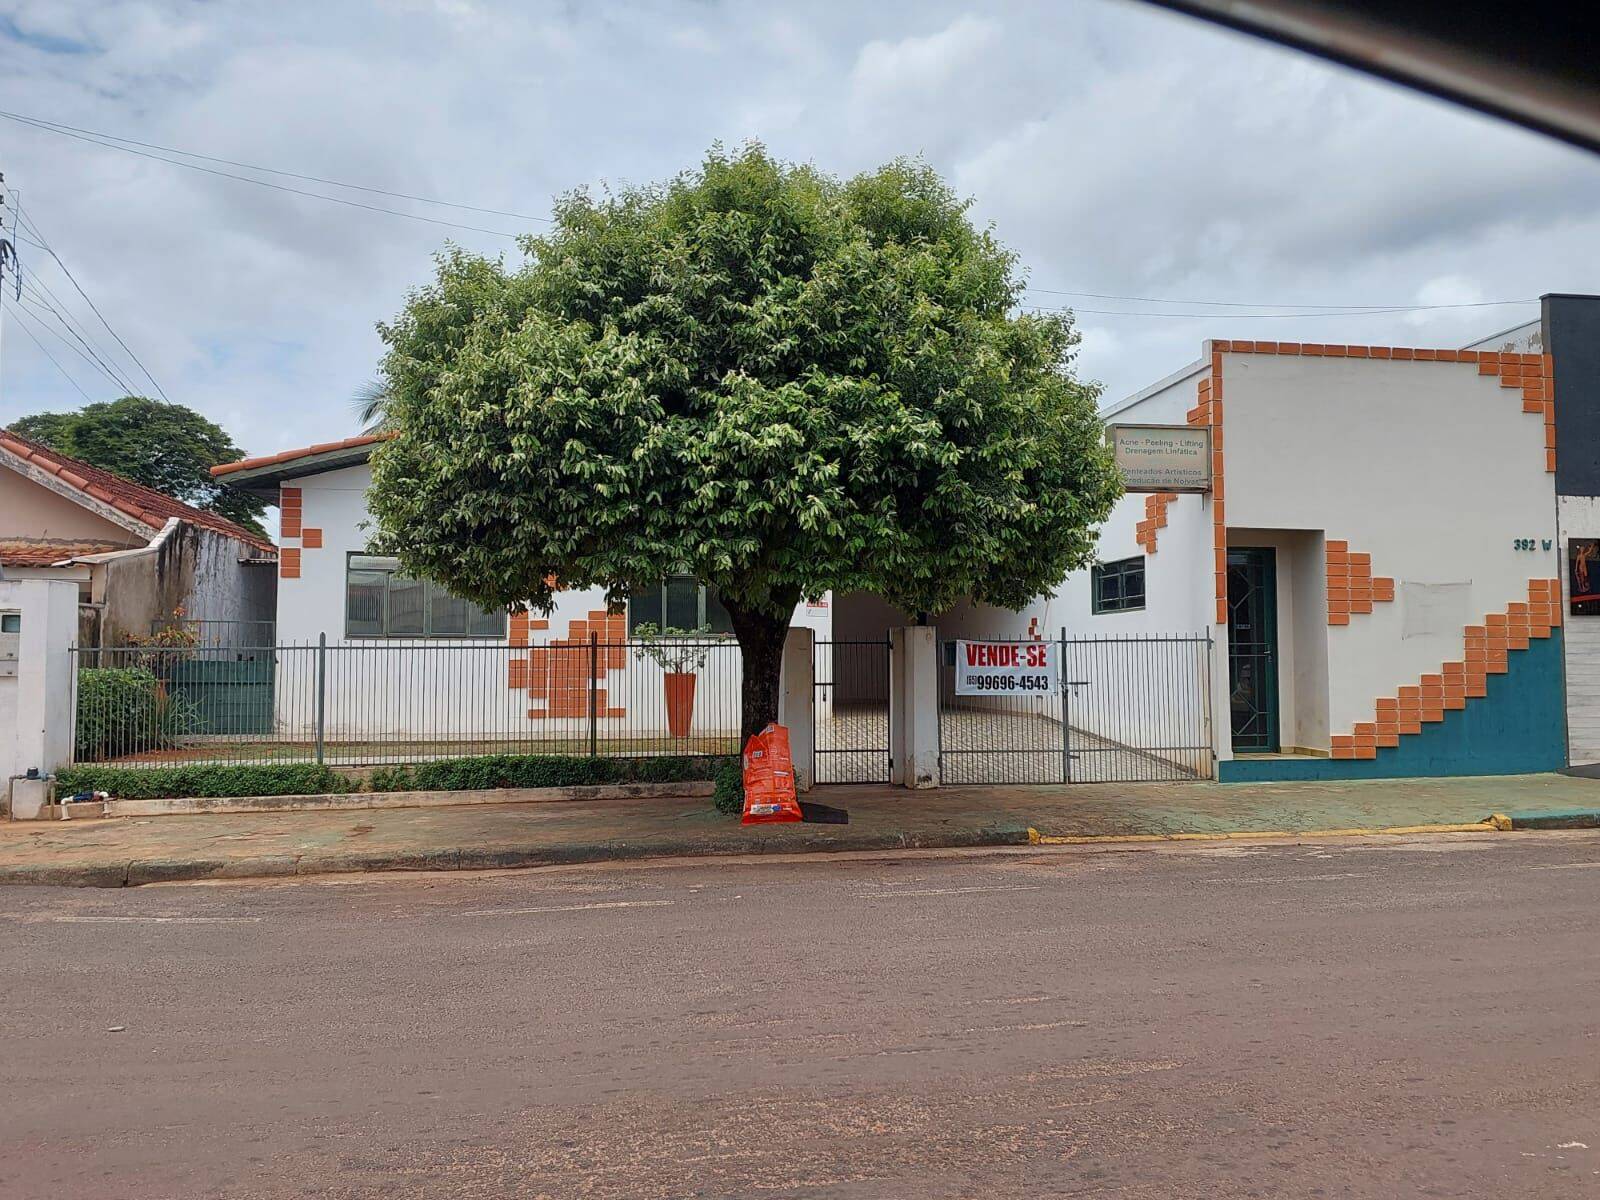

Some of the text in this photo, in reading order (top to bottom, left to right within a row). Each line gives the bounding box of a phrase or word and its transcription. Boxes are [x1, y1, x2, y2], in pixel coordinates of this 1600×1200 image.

[1145, 439, 1174, 448] Peeling
[1180, 439, 1204, 449] Lifting
[1125, 447, 1164, 456] Drenagem
[1514, 539, 1552, 551] 392 W
[966, 644, 1047, 666] VENDE-SE
[977, 675, 1049, 690] 99696-4543
